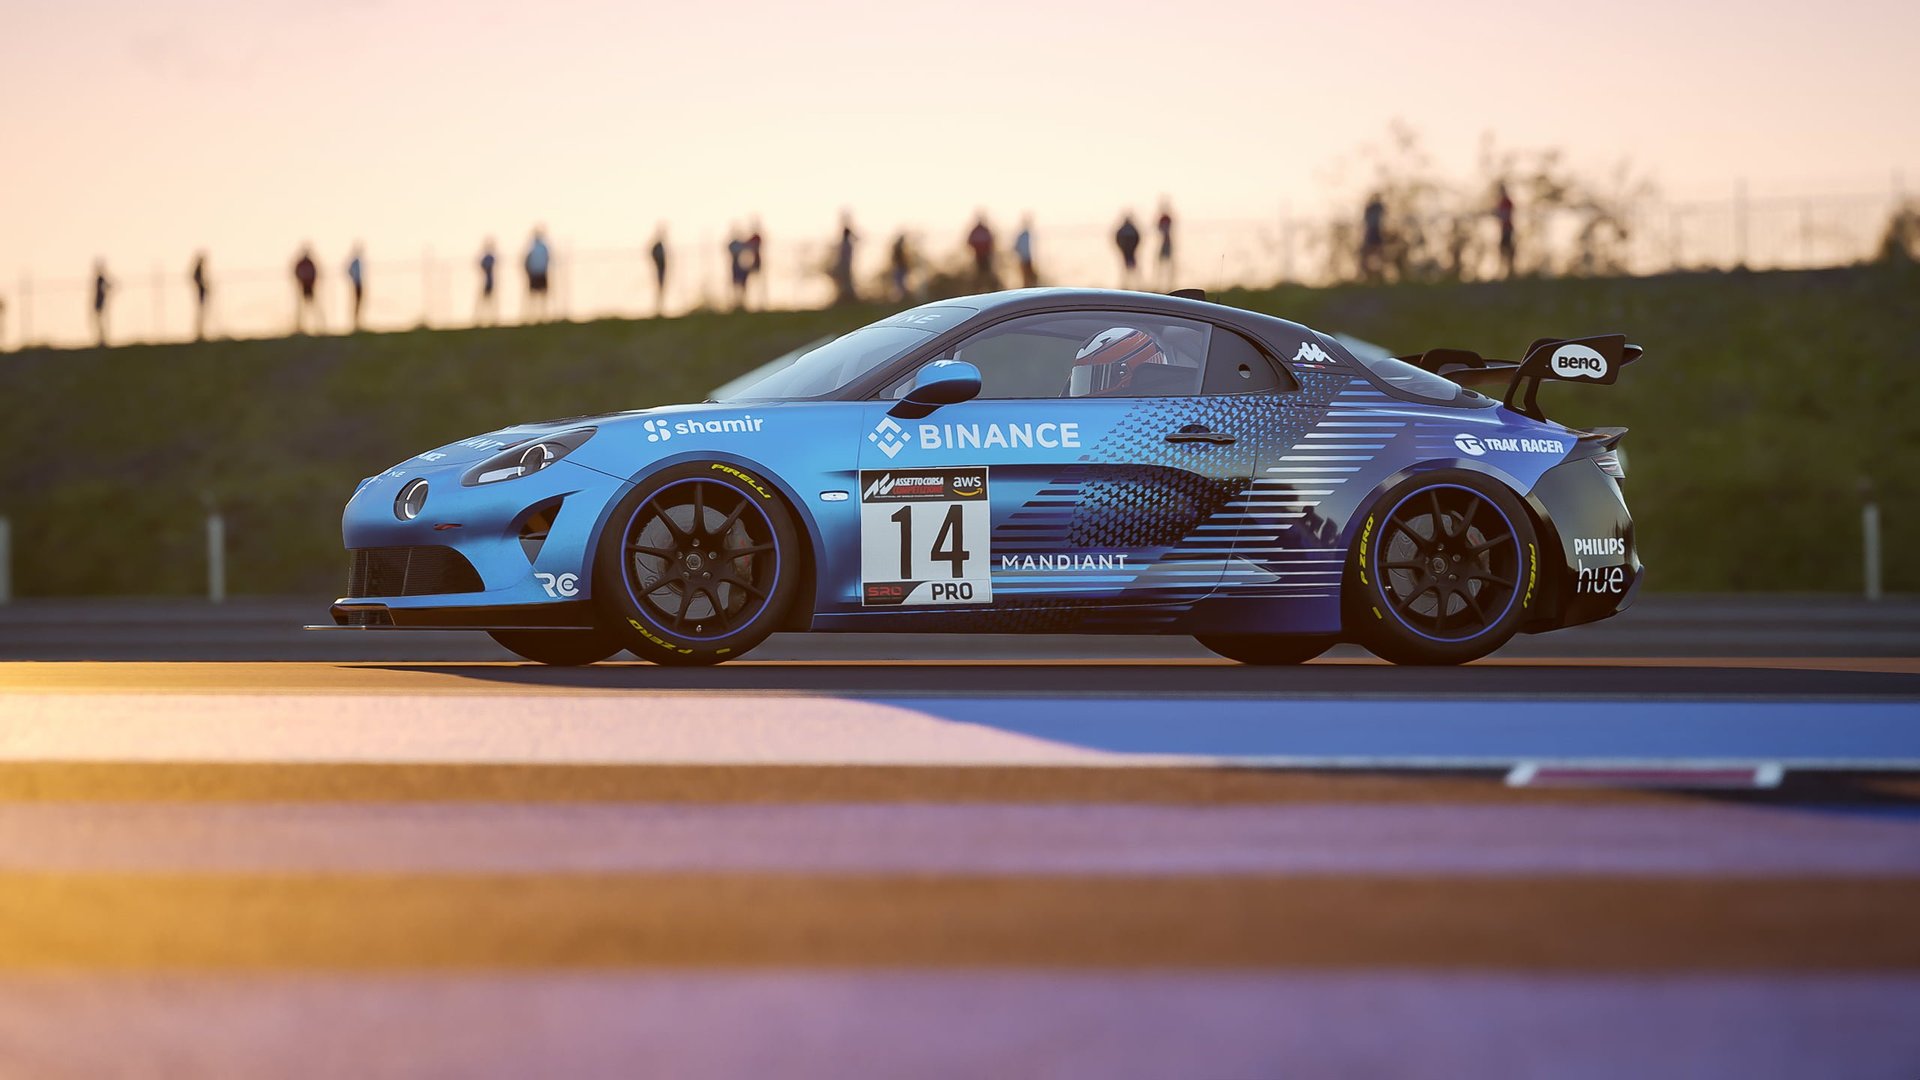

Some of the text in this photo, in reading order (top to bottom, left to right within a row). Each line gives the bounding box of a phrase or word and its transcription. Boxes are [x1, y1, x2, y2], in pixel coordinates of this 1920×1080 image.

[1558, 356, 1602, 372] BenQ
[674, 415, 763, 434] shamir
[918, 422, 1081, 450] BINANCE
[1484, 438, 1564, 453] TRAK RACER
[711, 463, 771, 498] PIRELLI
[895, 477, 944, 486] ASSETTO CORSA
[953, 476, 981, 488] aws
[890, 504, 970, 579] 14
[1360, 513, 1374, 568] ZERO
[1574, 538, 1625, 555] PHILIPS
[1002, 554, 1128, 570] MANDIANT
[1523, 543, 1536, 608] PIRELLI
[1577, 558, 1623, 593] hue
[931, 582, 974, 601] PRO
[626, 617, 676, 650] ZERO
